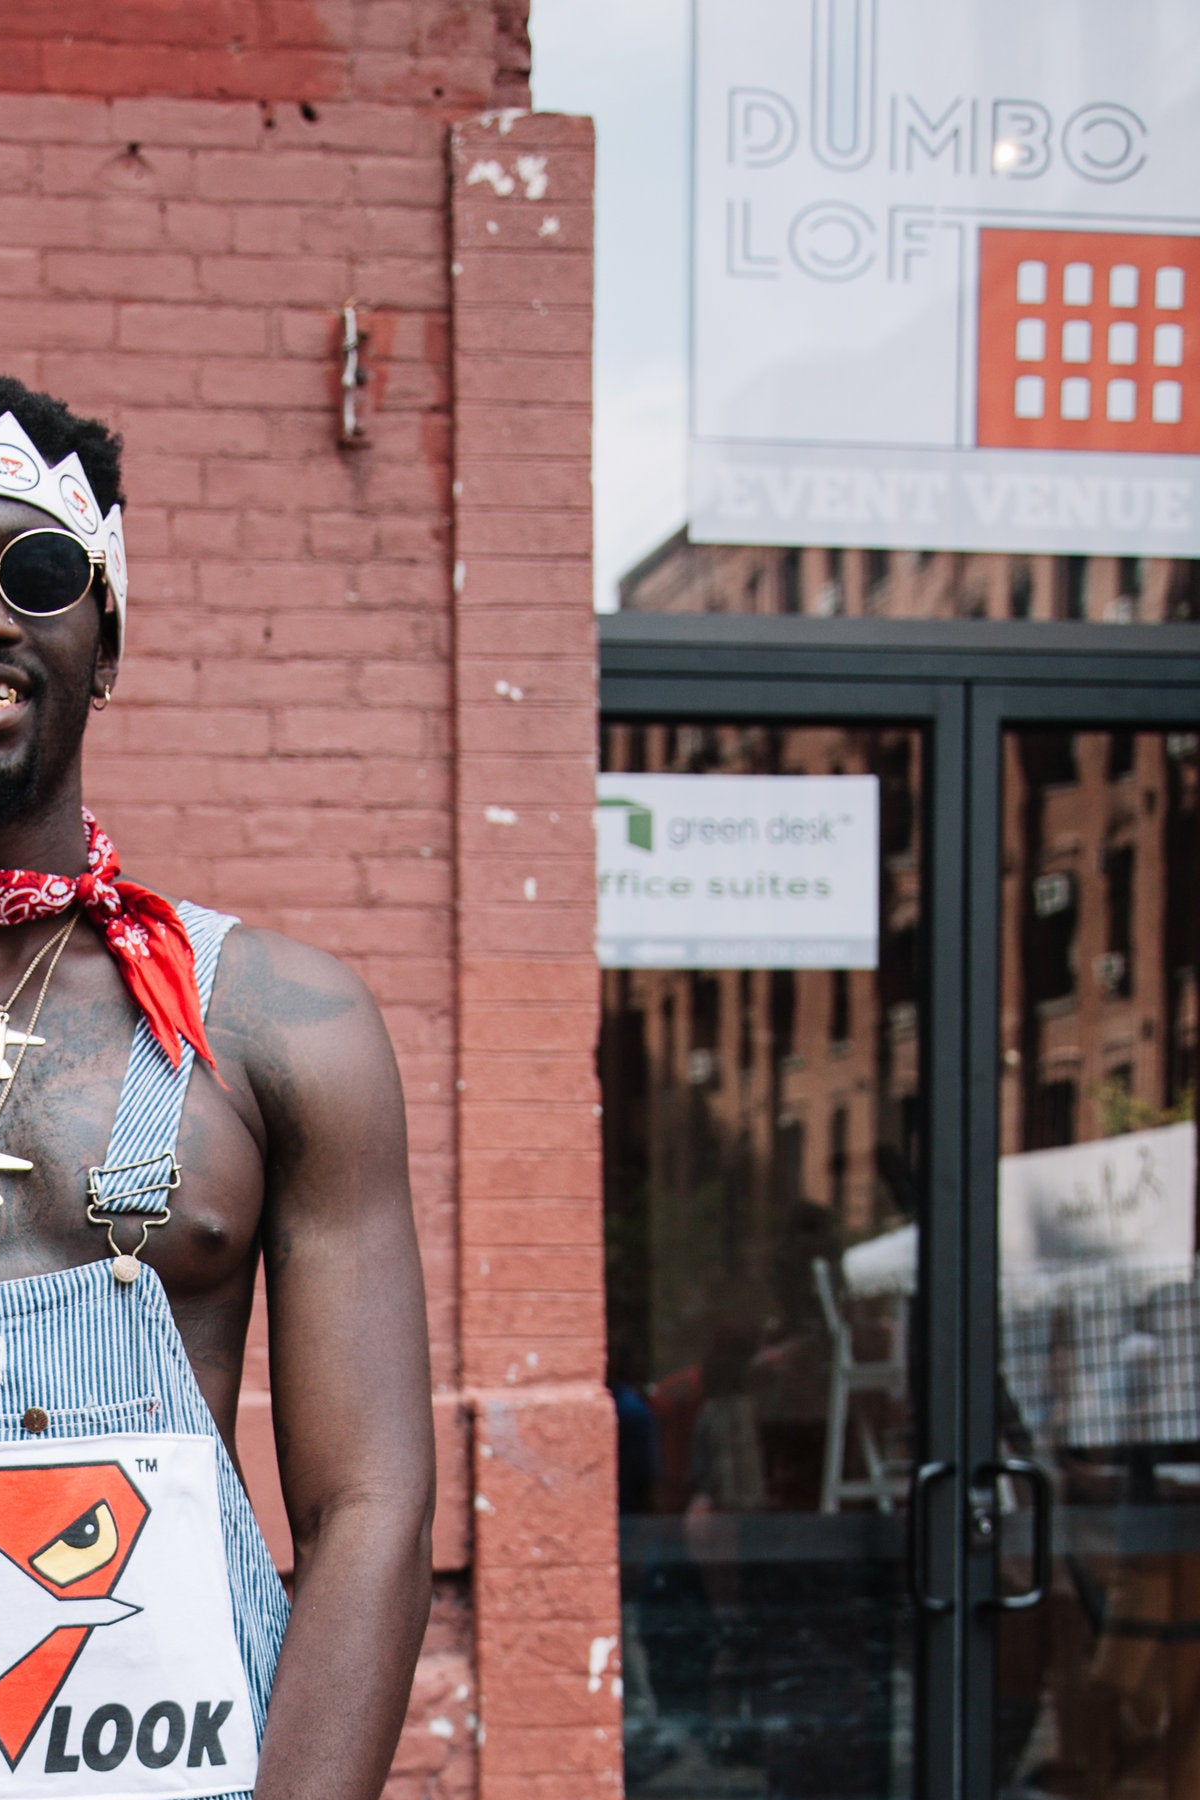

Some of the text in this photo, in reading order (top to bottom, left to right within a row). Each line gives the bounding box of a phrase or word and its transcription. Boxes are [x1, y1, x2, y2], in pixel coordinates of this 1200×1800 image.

[718, 467, 1192, 531] EVENT VENUE
[667, 816, 759, 847] green
[765, 812, 837, 845] desk
[597, 867, 833, 897] ffice suites
[134, 1458, 158, 1473] TM
[44, 1700, 234, 1774] LOOK
